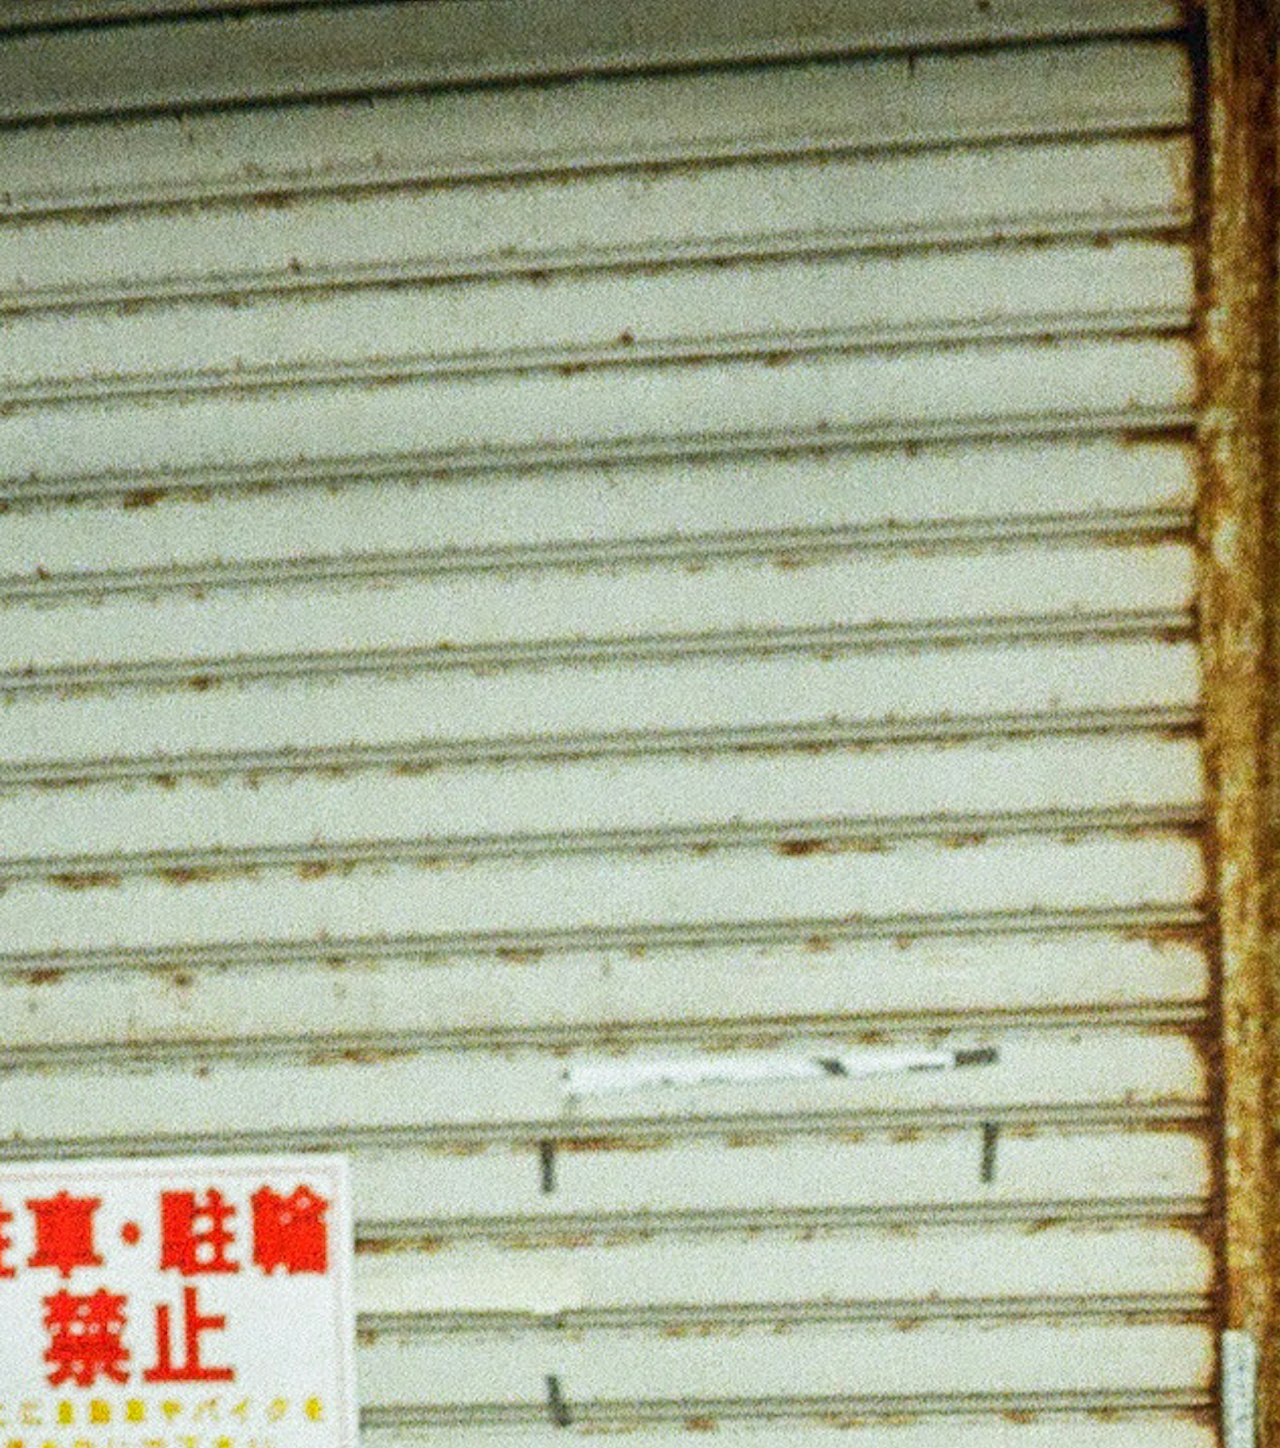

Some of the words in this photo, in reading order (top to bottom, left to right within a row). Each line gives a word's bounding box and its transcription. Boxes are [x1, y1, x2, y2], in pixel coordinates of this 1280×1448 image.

[0, 1184, 330, 1280] 車・駐輪
[42, 1286, 236, 1388] 禁止
